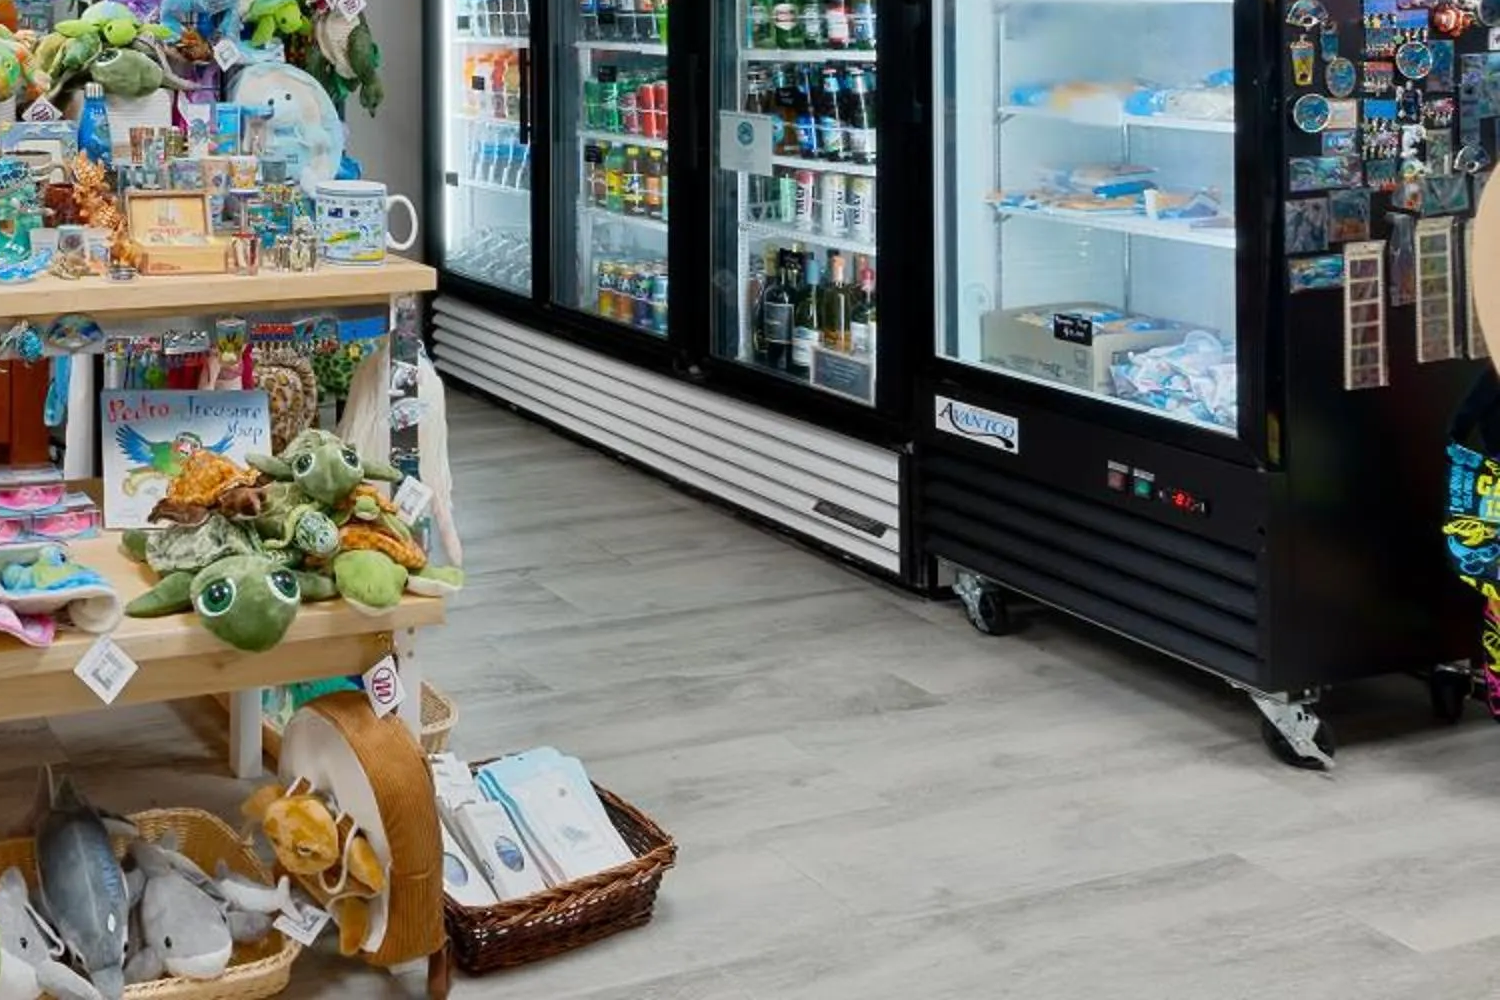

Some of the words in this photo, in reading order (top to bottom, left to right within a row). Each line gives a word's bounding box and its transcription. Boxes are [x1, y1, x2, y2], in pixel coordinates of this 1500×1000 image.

[107, 394, 170, 424] Pedro
[180, 395, 263, 422] Treasure
[938, 402, 1016, 440] AVANTCO
